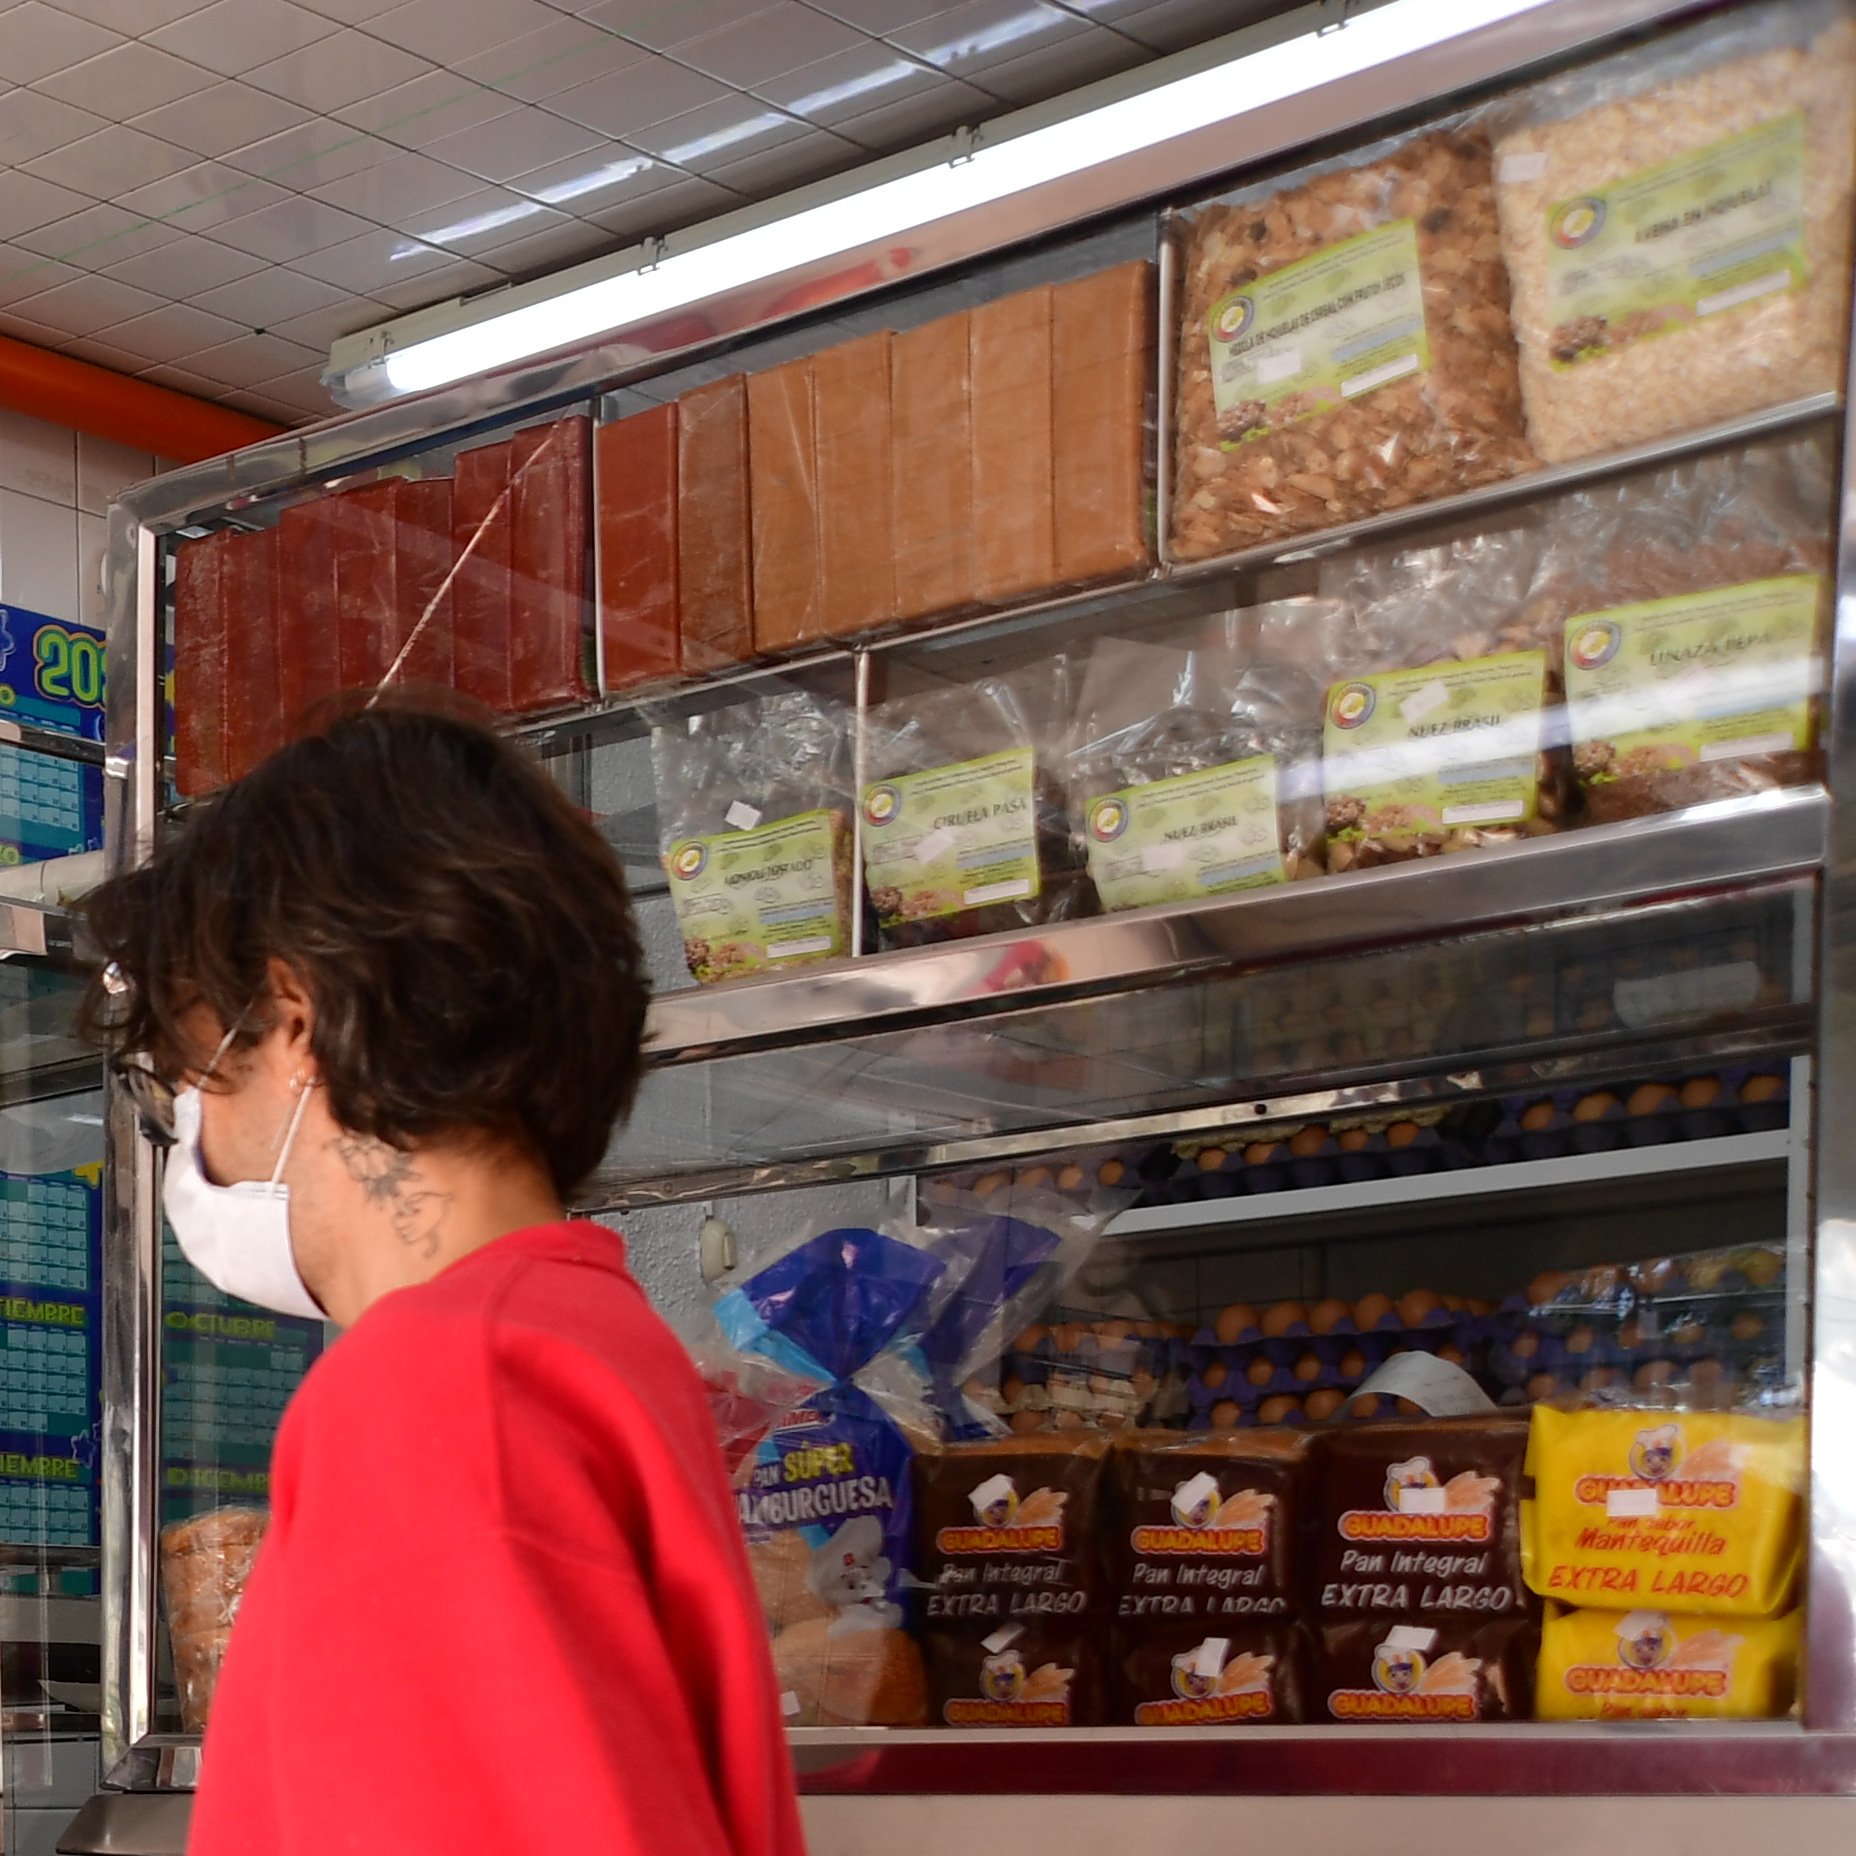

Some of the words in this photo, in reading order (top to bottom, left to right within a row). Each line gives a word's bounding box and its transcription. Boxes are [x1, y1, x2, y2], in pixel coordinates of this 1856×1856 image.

[933, 803, 988, 830] CIRUELA
[991, 798, 1027, 818] PASA
[754, 1465, 780, 1488] PAN
[783, 1440, 855, 1482] SÚPER
[738, 1475, 893, 1525] AMBURGUESA
[938, 1527, 1063, 1553] GUADALUPE
[1341, 1514, 1489, 1540] GUADALUPE
[1133, 1529, 1267, 1554] GUADALUPE
[1575, 1527, 1726, 1558] Mantequilla
[940, 1563, 975, 1584] Pan
[981, 1561, 1061, 1586] Integral
[1132, 1563, 1168, 1585] Pan
[1175, 1563, 1264, 1588] Integral
[1340, 1549, 1384, 1573] Pan
[1390, 1549, 1488, 1577] Integral
[1547, 1565, 1638, 1593] EXTRA
[1651, 1568, 1750, 1600] LARGO
[927, 1593, 998, 1617] EXTRA
[1008, 1590, 1086, 1615] LARGO
[1321, 1584, 1407, 1609] EXTRA
[1419, 1584, 1512, 1611] LARGO
[1566, 1667, 1728, 1696] GUADALUPE
[944, 1701, 1070, 1725] GUADALUPE
[1136, 1692, 1273, 1725] GUADALUPE
[1330, 1694, 1479, 1720] GUADALUPE
